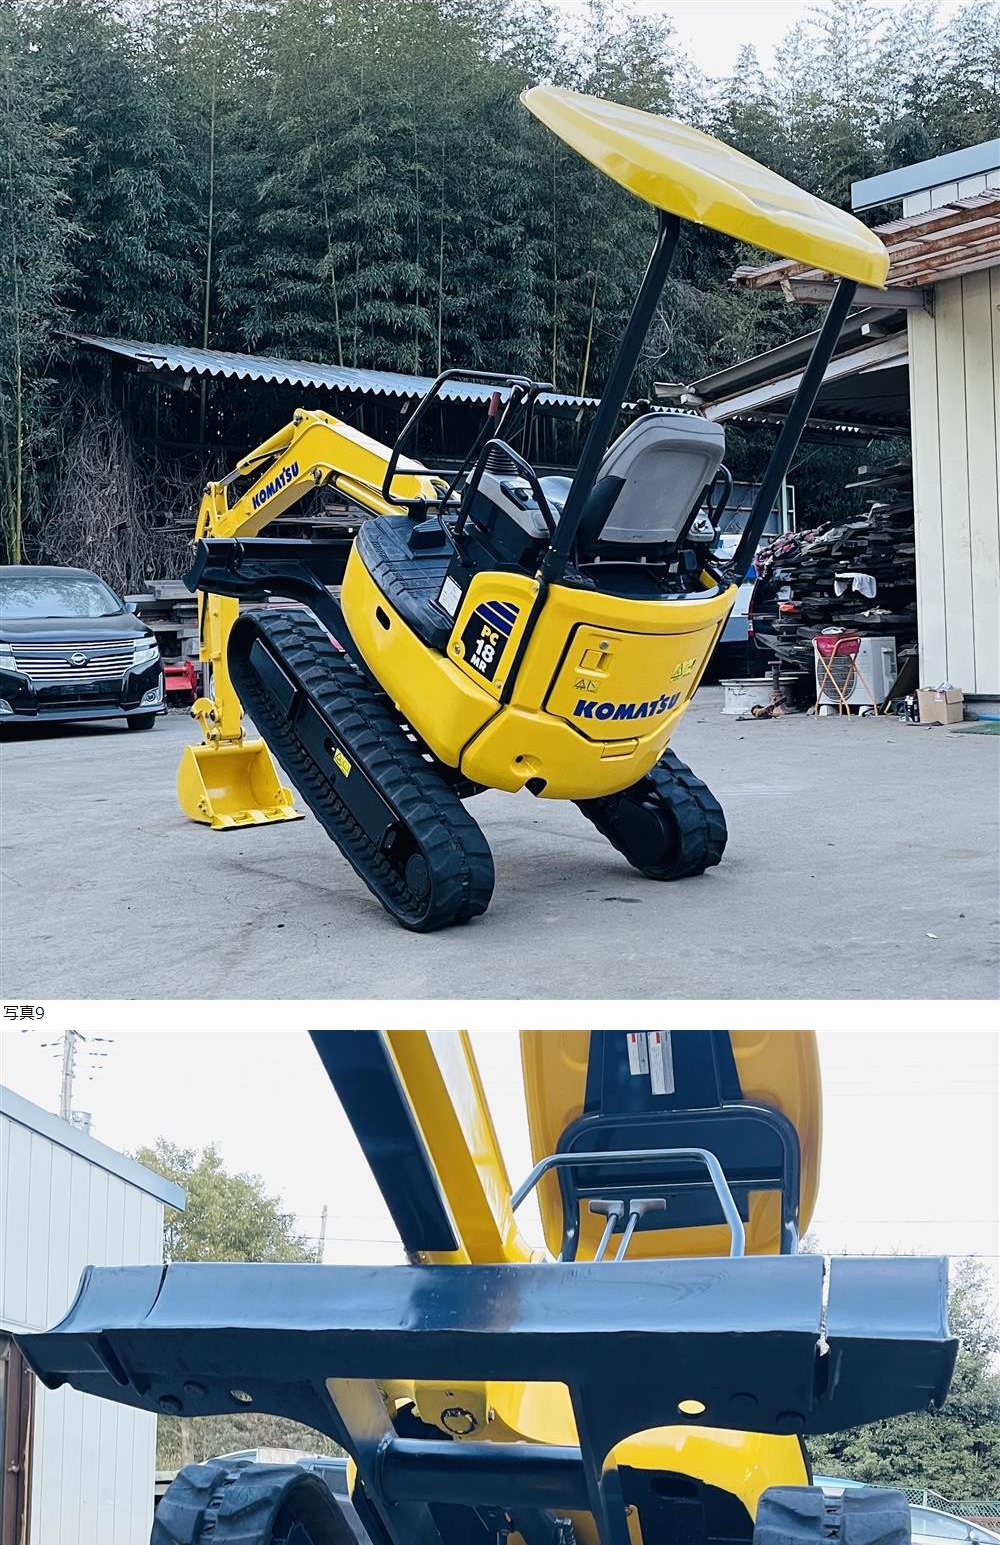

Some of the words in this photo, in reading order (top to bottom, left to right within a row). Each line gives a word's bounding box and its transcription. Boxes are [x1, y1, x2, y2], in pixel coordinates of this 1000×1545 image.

[252, 461, 299, 510] KOMATSU
[481, 624, 500, 646] PC
[476, 639, 496, 663] 18
[470, 654, 487, 673] MR
[573, 691, 681, 720] KOMATSU
